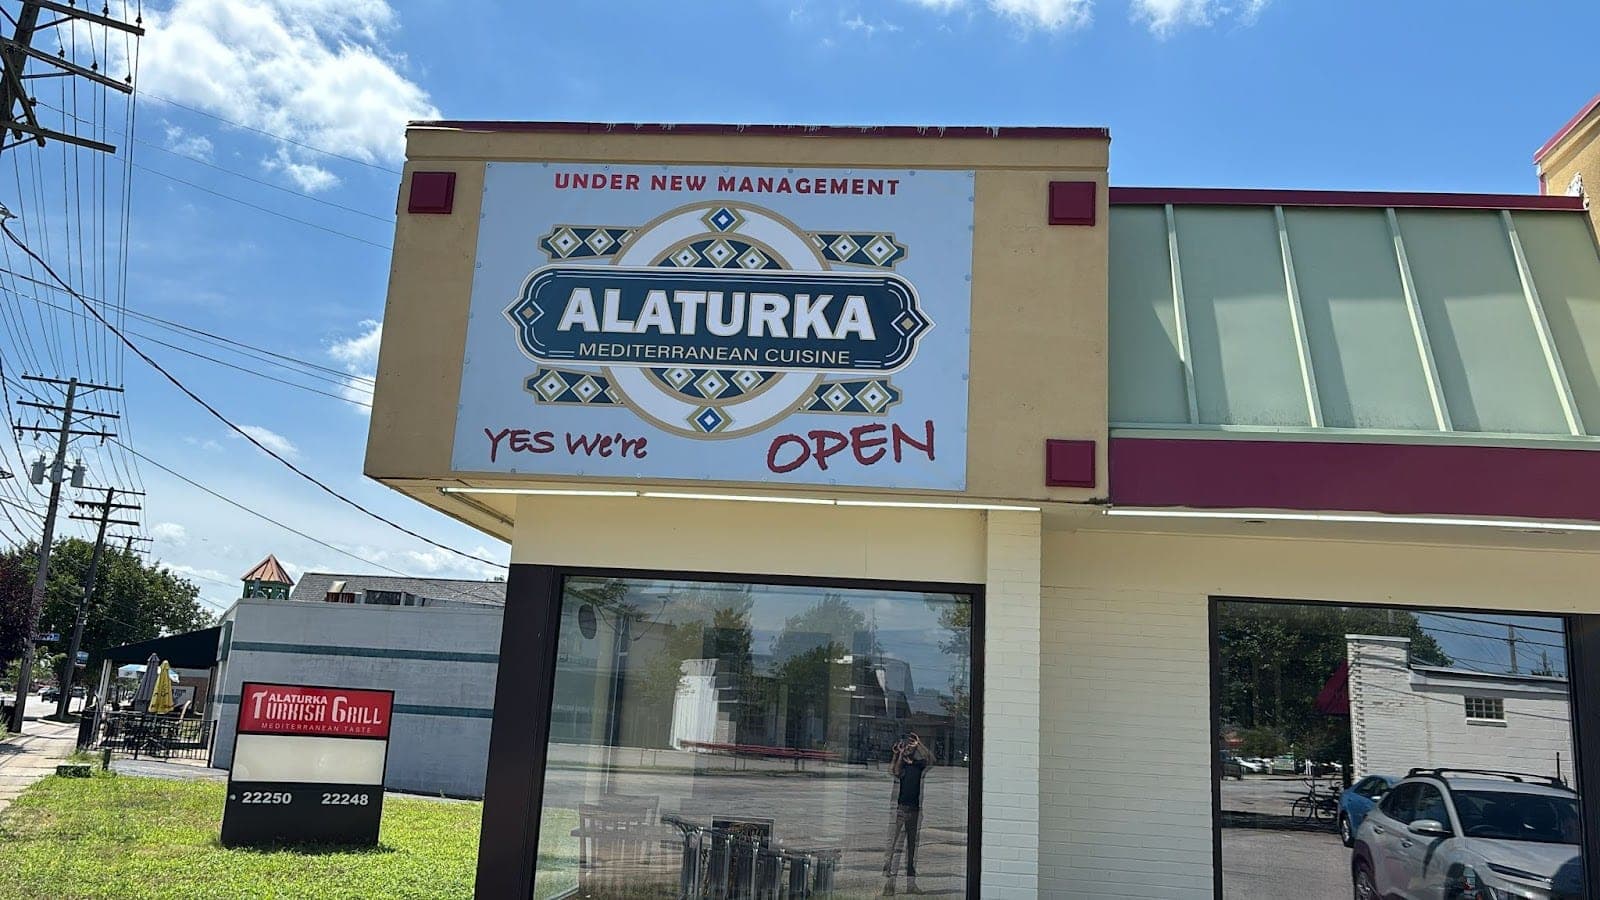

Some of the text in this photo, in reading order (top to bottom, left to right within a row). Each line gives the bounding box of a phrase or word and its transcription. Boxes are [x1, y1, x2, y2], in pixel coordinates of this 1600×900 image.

[555, 173, 900, 196] UNDER NEW MANAGEMENT
[557, 287, 877, 342] ALATURKA
[579, 342, 850, 366] MEDITERRANEAN CUISINE
[485, 428, 648, 463] YES We're
[767, 420, 936, 474] OPEN
[268, 694, 328, 705] ALATURKA
[261, 722, 339, 732] MEDITERRANEAN
[241, 792, 369, 806] 22250 22248
